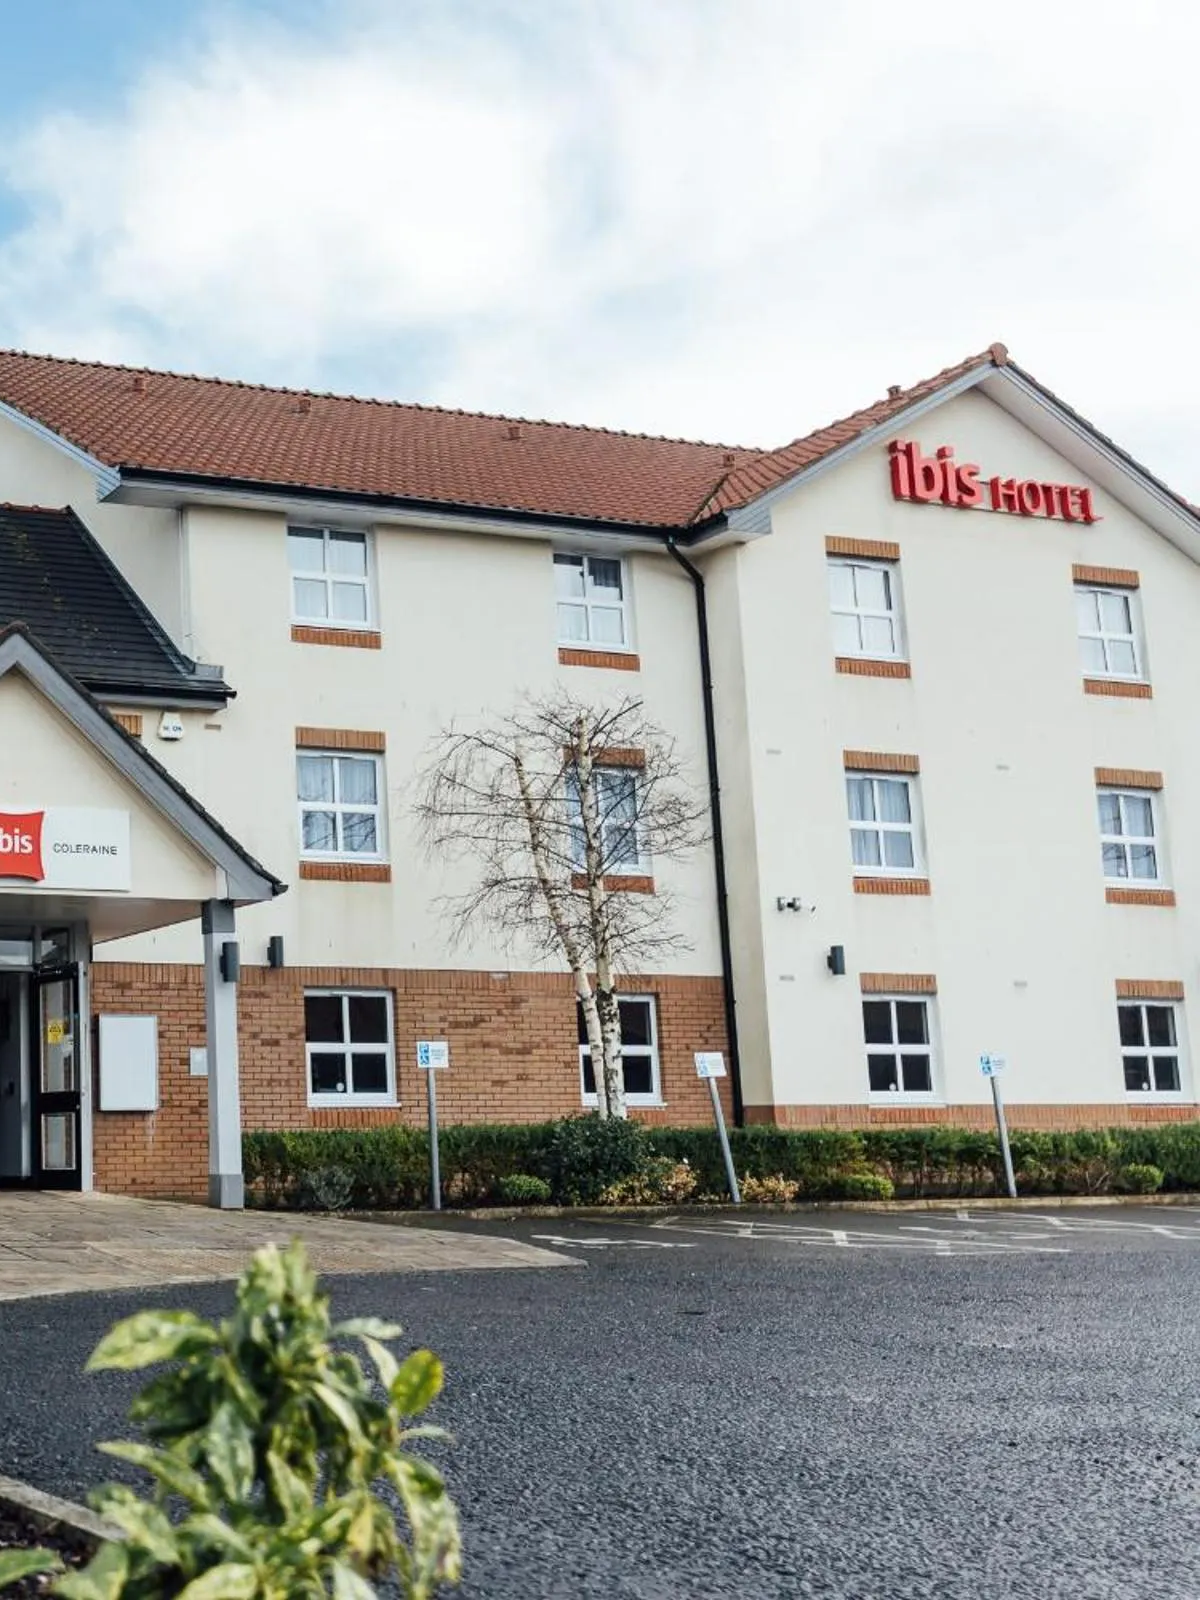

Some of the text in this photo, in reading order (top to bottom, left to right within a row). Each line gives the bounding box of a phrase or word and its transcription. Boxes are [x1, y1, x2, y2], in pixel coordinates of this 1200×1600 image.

[888, 439, 1102, 524] ibis HOTEL
[52, 842, 118, 856] COLERAINE
